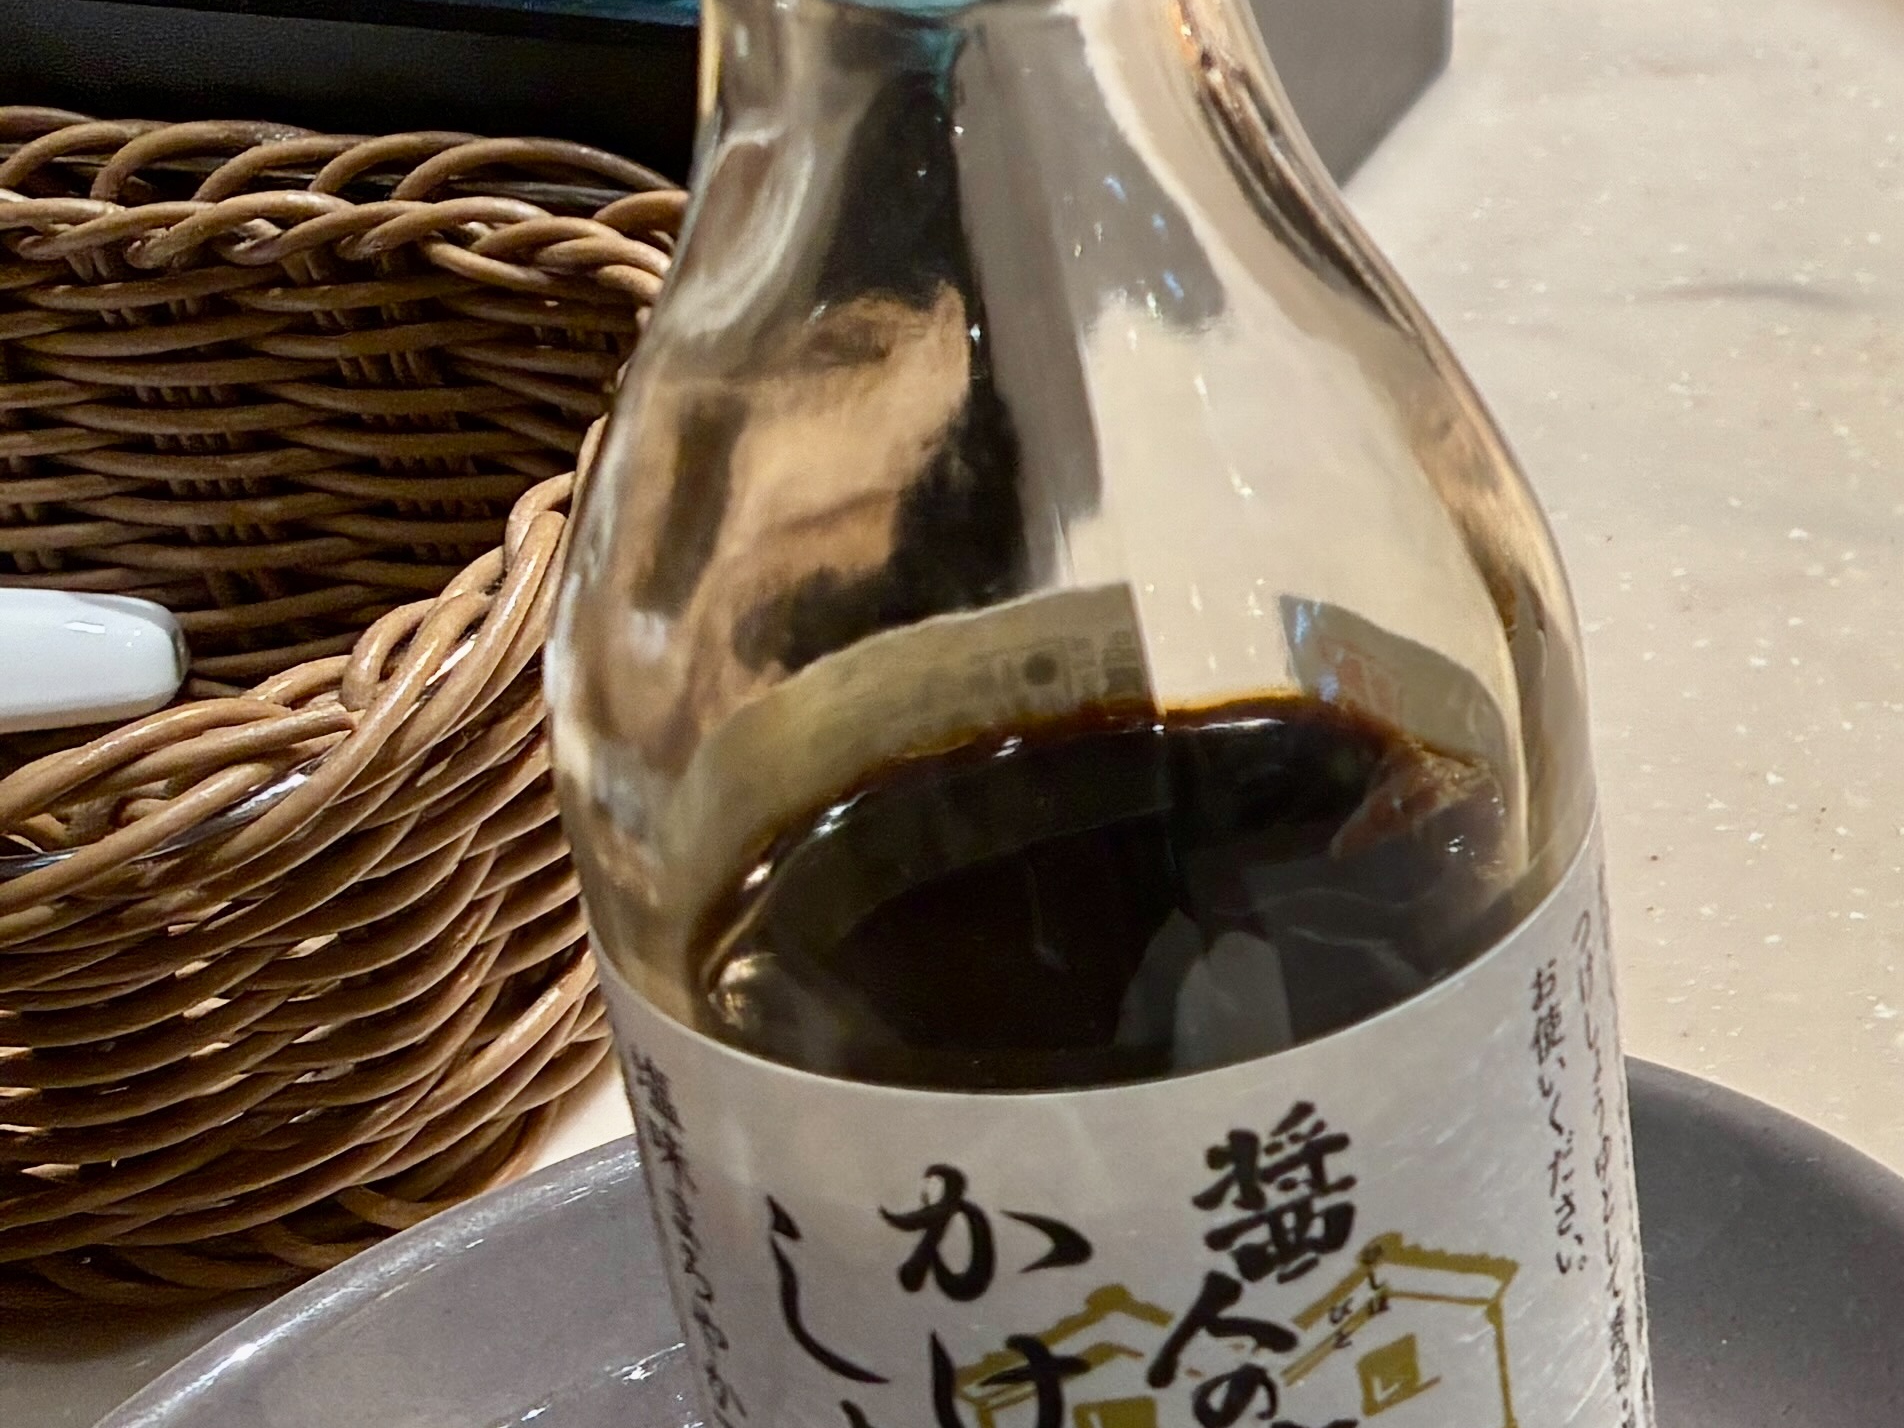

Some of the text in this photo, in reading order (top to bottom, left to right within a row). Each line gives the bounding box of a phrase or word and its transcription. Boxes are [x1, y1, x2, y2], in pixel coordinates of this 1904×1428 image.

[1530, 957, 1589, 1275] お使いください。
